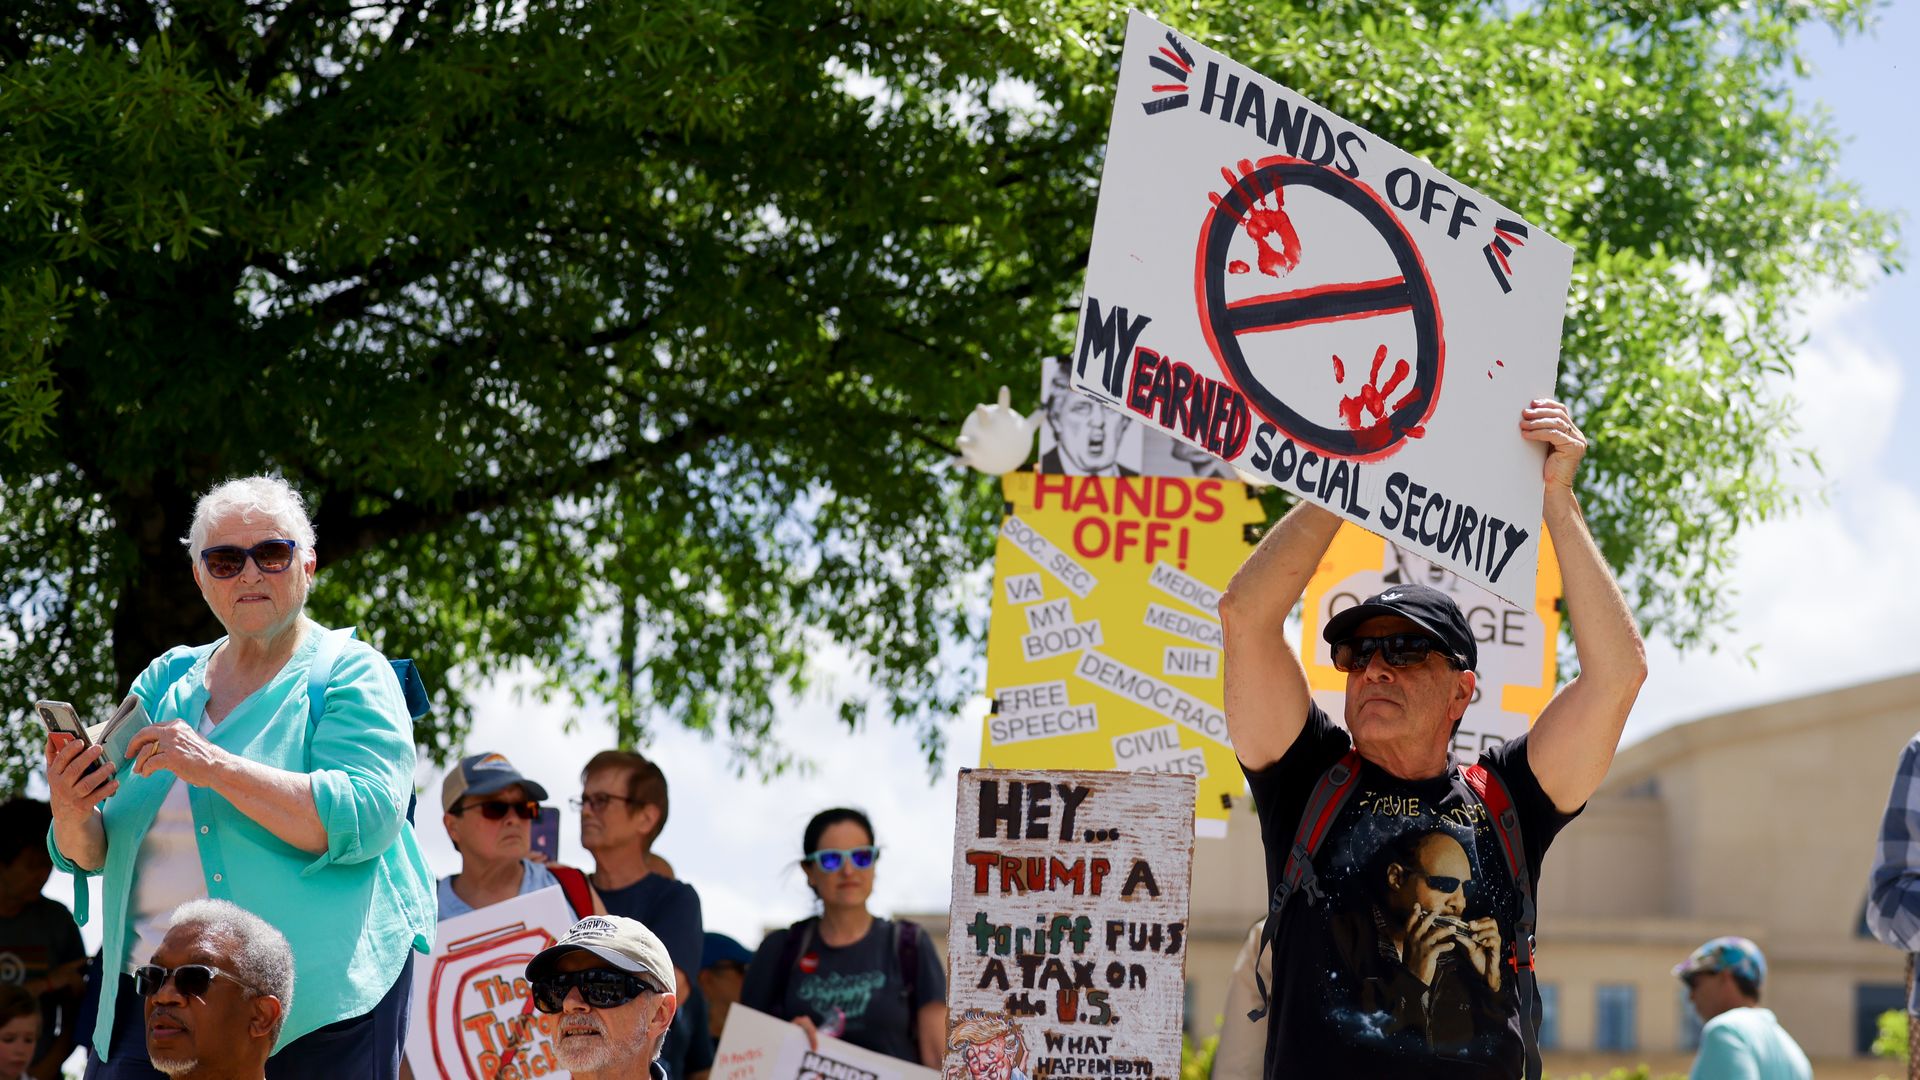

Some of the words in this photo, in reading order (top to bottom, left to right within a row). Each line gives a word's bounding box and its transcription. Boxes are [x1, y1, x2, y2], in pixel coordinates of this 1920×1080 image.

[1200, 62, 1367, 179] HANDS
[1385, 166, 1481, 240] OFF
[1077, 296, 1152, 399] MY
[1127, 346, 1251, 461] EARNED
[1250, 422, 1370, 521] SOCIAL
[1380, 472, 1529, 583] SECURITY
[1034, 474, 1224, 523] HANDS
[1003, 518, 1045, 561] SOC.
[1049, 553, 1090, 596] SEC.
[1073, 517, 1189, 571] OFF!
[1006, 578, 1041, 601] VA
[1151, 566, 1219, 611] MEDIC
[1029, 602, 1069, 629] MY
[1026, 623, 1098, 657] BODY
[1167, 651, 1211, 673] NIH
[998, 685, 1064, 711] FREE
[1080, 654, 1230, 742] DEMOCRAC
[991, 707, 1095, 741] SPEECH
[1115, 728, 1179, 759] CIVIL
[978, 781, 1120, 842] HEY...
[966, 852, 1111, 895] TRUMP
[1121, 861, 1160, 896] A
[967, 912, 1092, 955] tariff
[978, 958, 1009, 991] A
[1016, 955, 1096, 991] TAX
[1056, 989, 1120, 1025] U.S.
[1043, 1031, 1112, 1055] WHAT
[1037, 1057, 1133, 1076] HAPPENED
